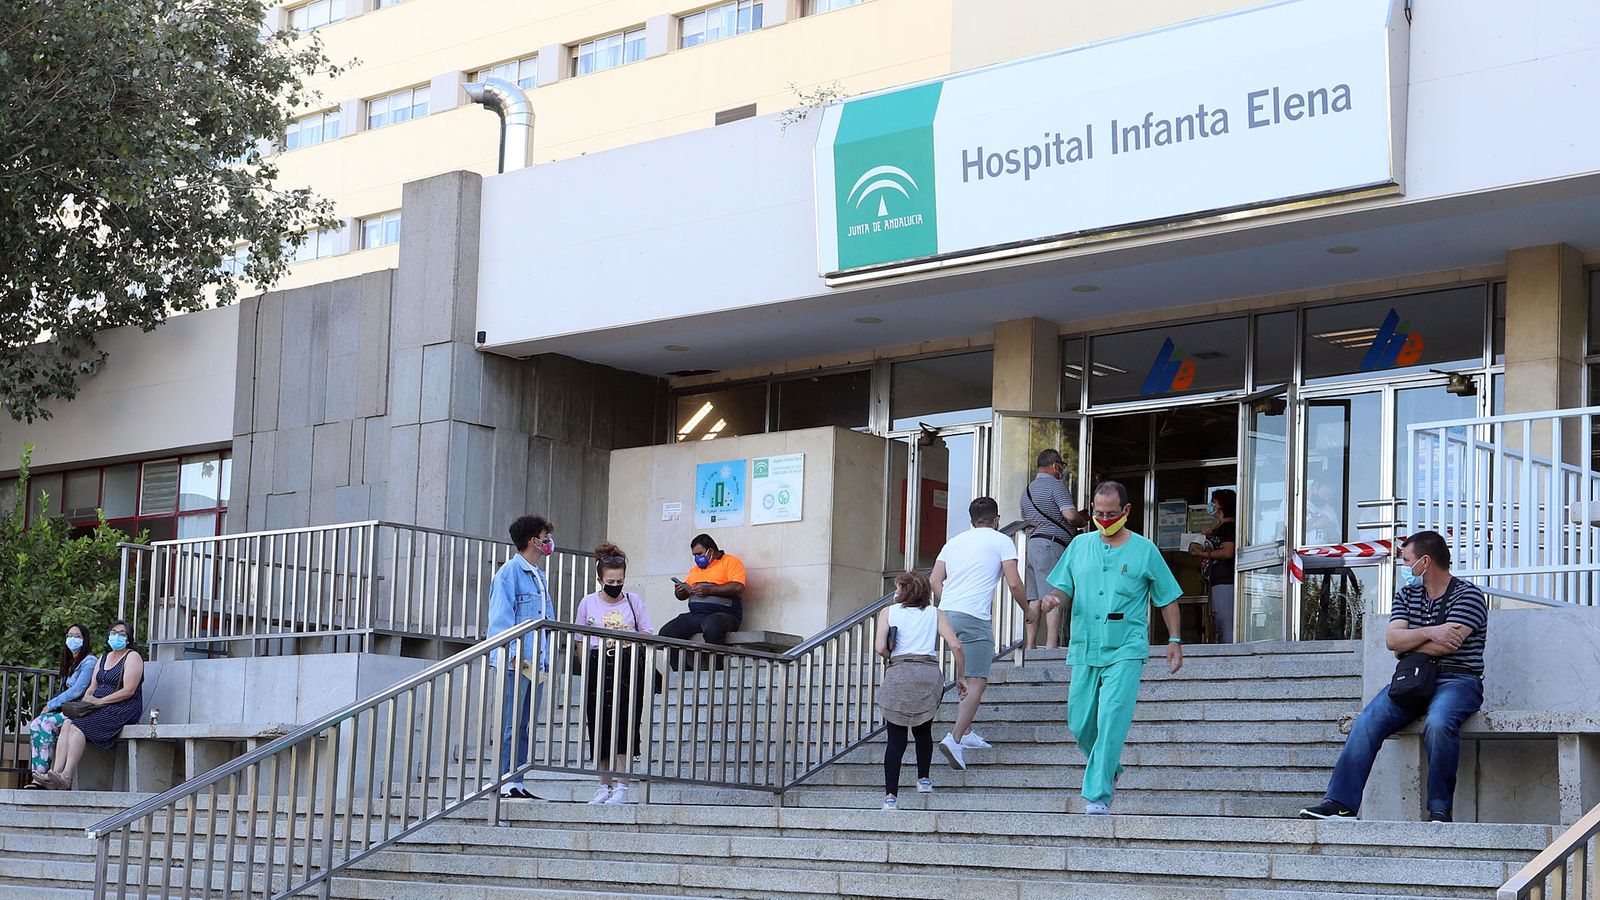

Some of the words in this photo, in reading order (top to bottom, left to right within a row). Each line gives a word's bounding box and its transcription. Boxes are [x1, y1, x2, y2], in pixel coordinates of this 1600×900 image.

[962, 123, 1093, 183] Hospital
[1111, 103, 1230, 155] Infanta
[1247, 83, 1352, 129] Elena
[848, 223, 870, 237] JUNTA
[873, 221, 882, 233] DE
[884, 213, 924, 230] ANDALUCIA
